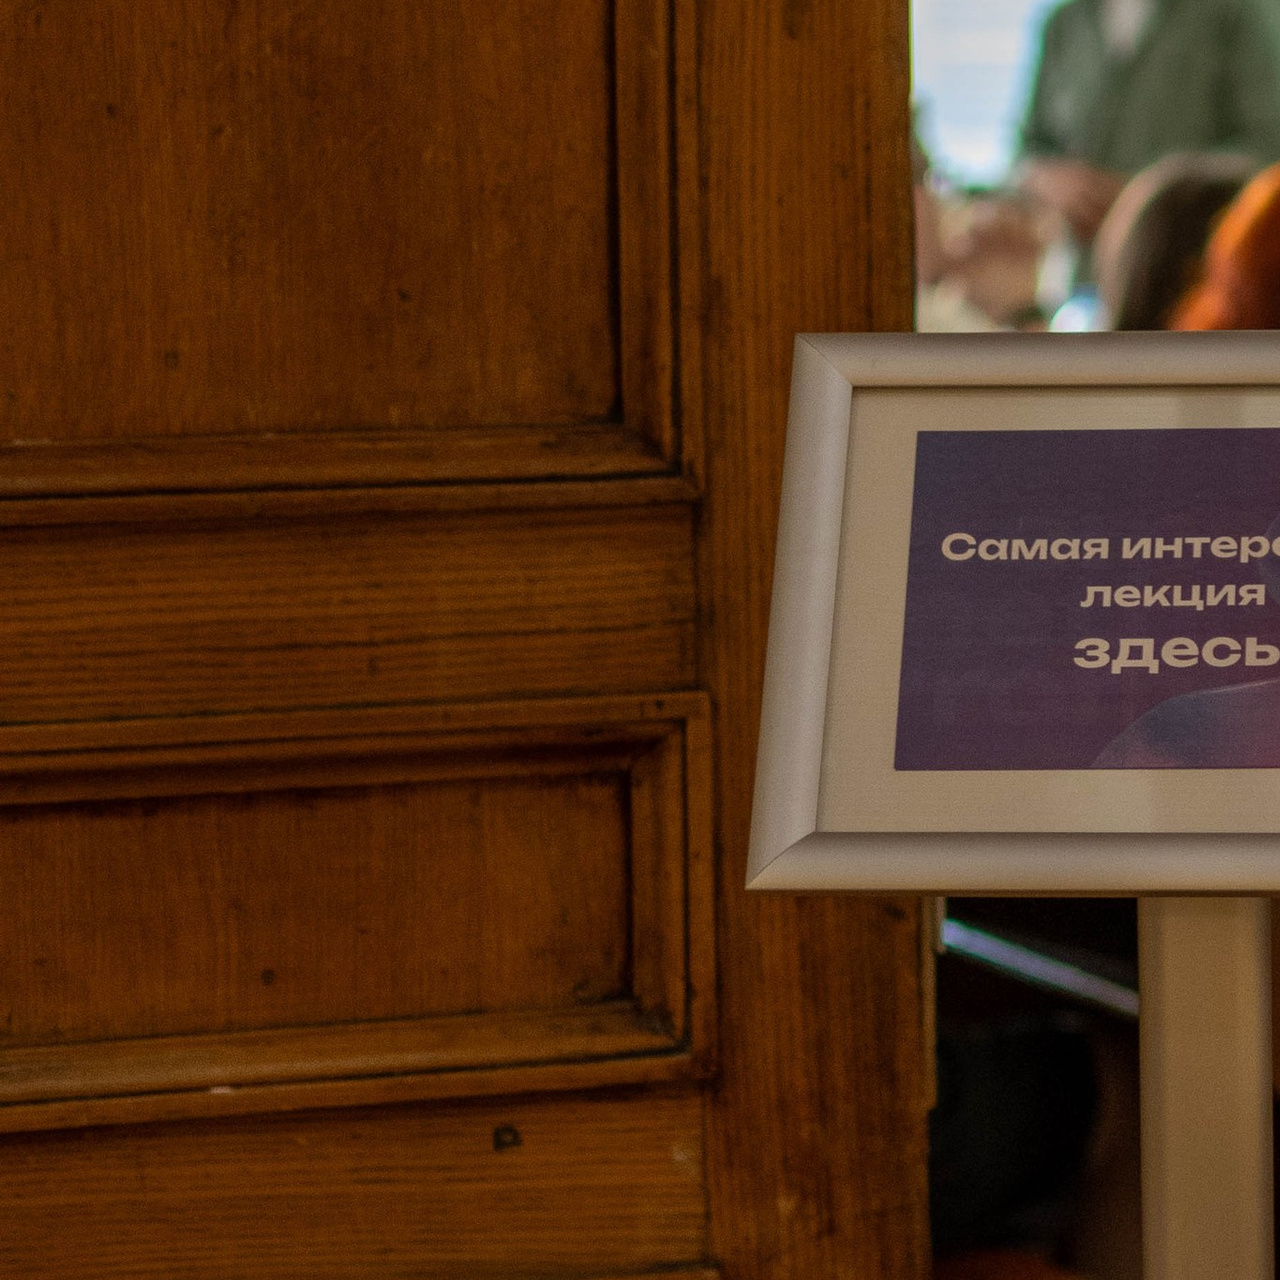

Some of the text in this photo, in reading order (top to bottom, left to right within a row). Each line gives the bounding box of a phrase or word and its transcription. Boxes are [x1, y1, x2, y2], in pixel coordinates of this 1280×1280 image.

[941, 532, 1110, 561] Самая
[1079, 584, 1266, 611] лекция
[1073, 636, 1280, 675] здесь
